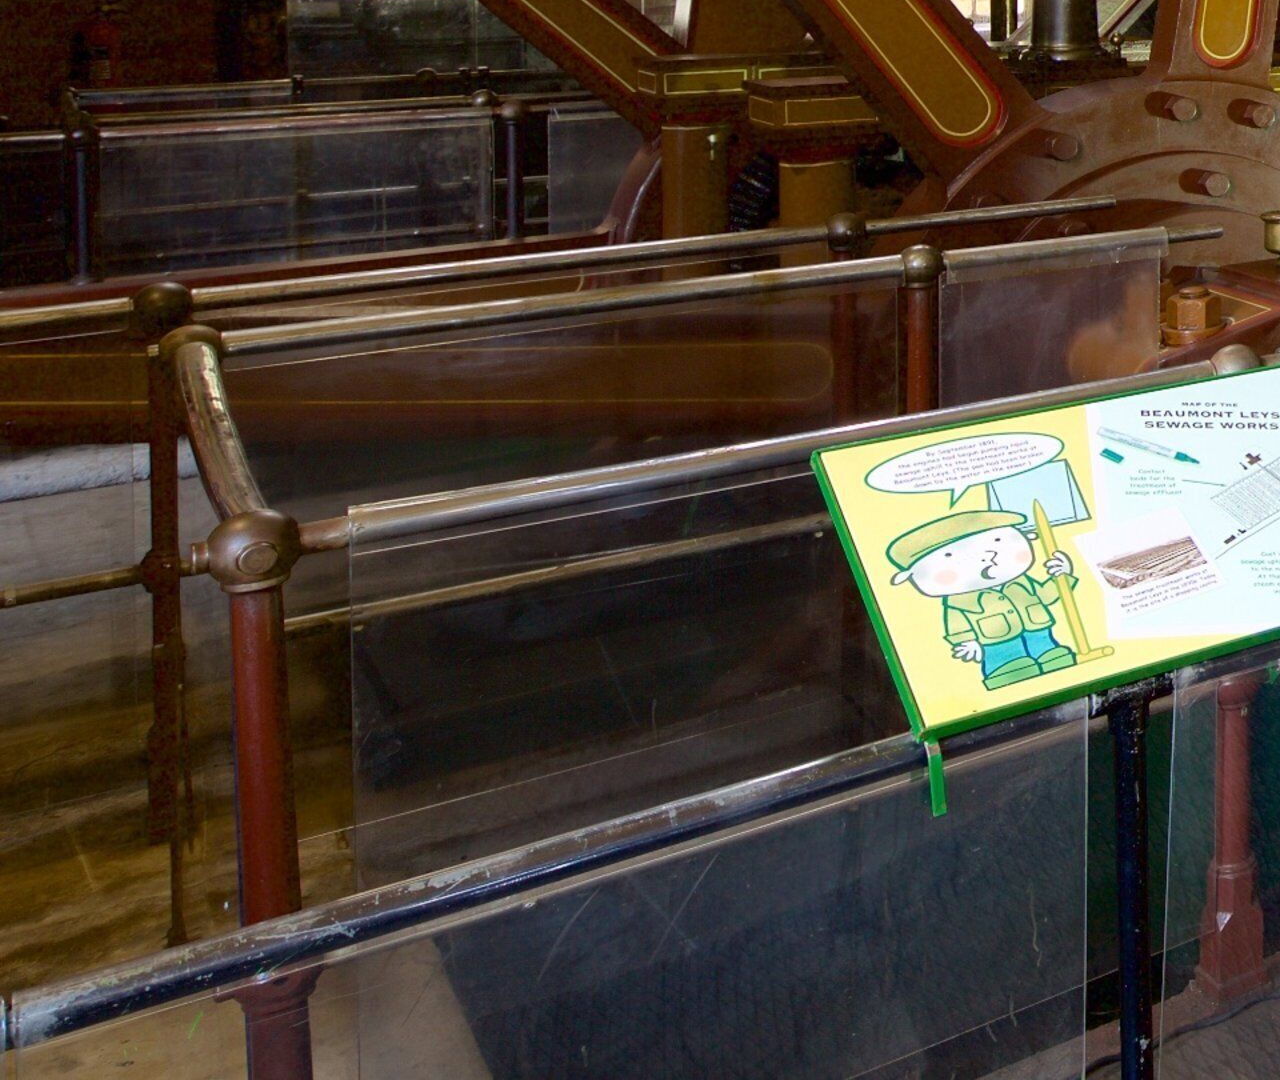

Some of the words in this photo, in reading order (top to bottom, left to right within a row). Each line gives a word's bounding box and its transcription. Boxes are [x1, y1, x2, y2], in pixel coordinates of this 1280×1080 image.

[1140, 410, 1233, 418] BEAUMONT
[1240, 411, 1280, 419] LEYS
[1144, 421, 1214, 429] SEWAGE
[1220, 422, 1279, 430] WORKS
